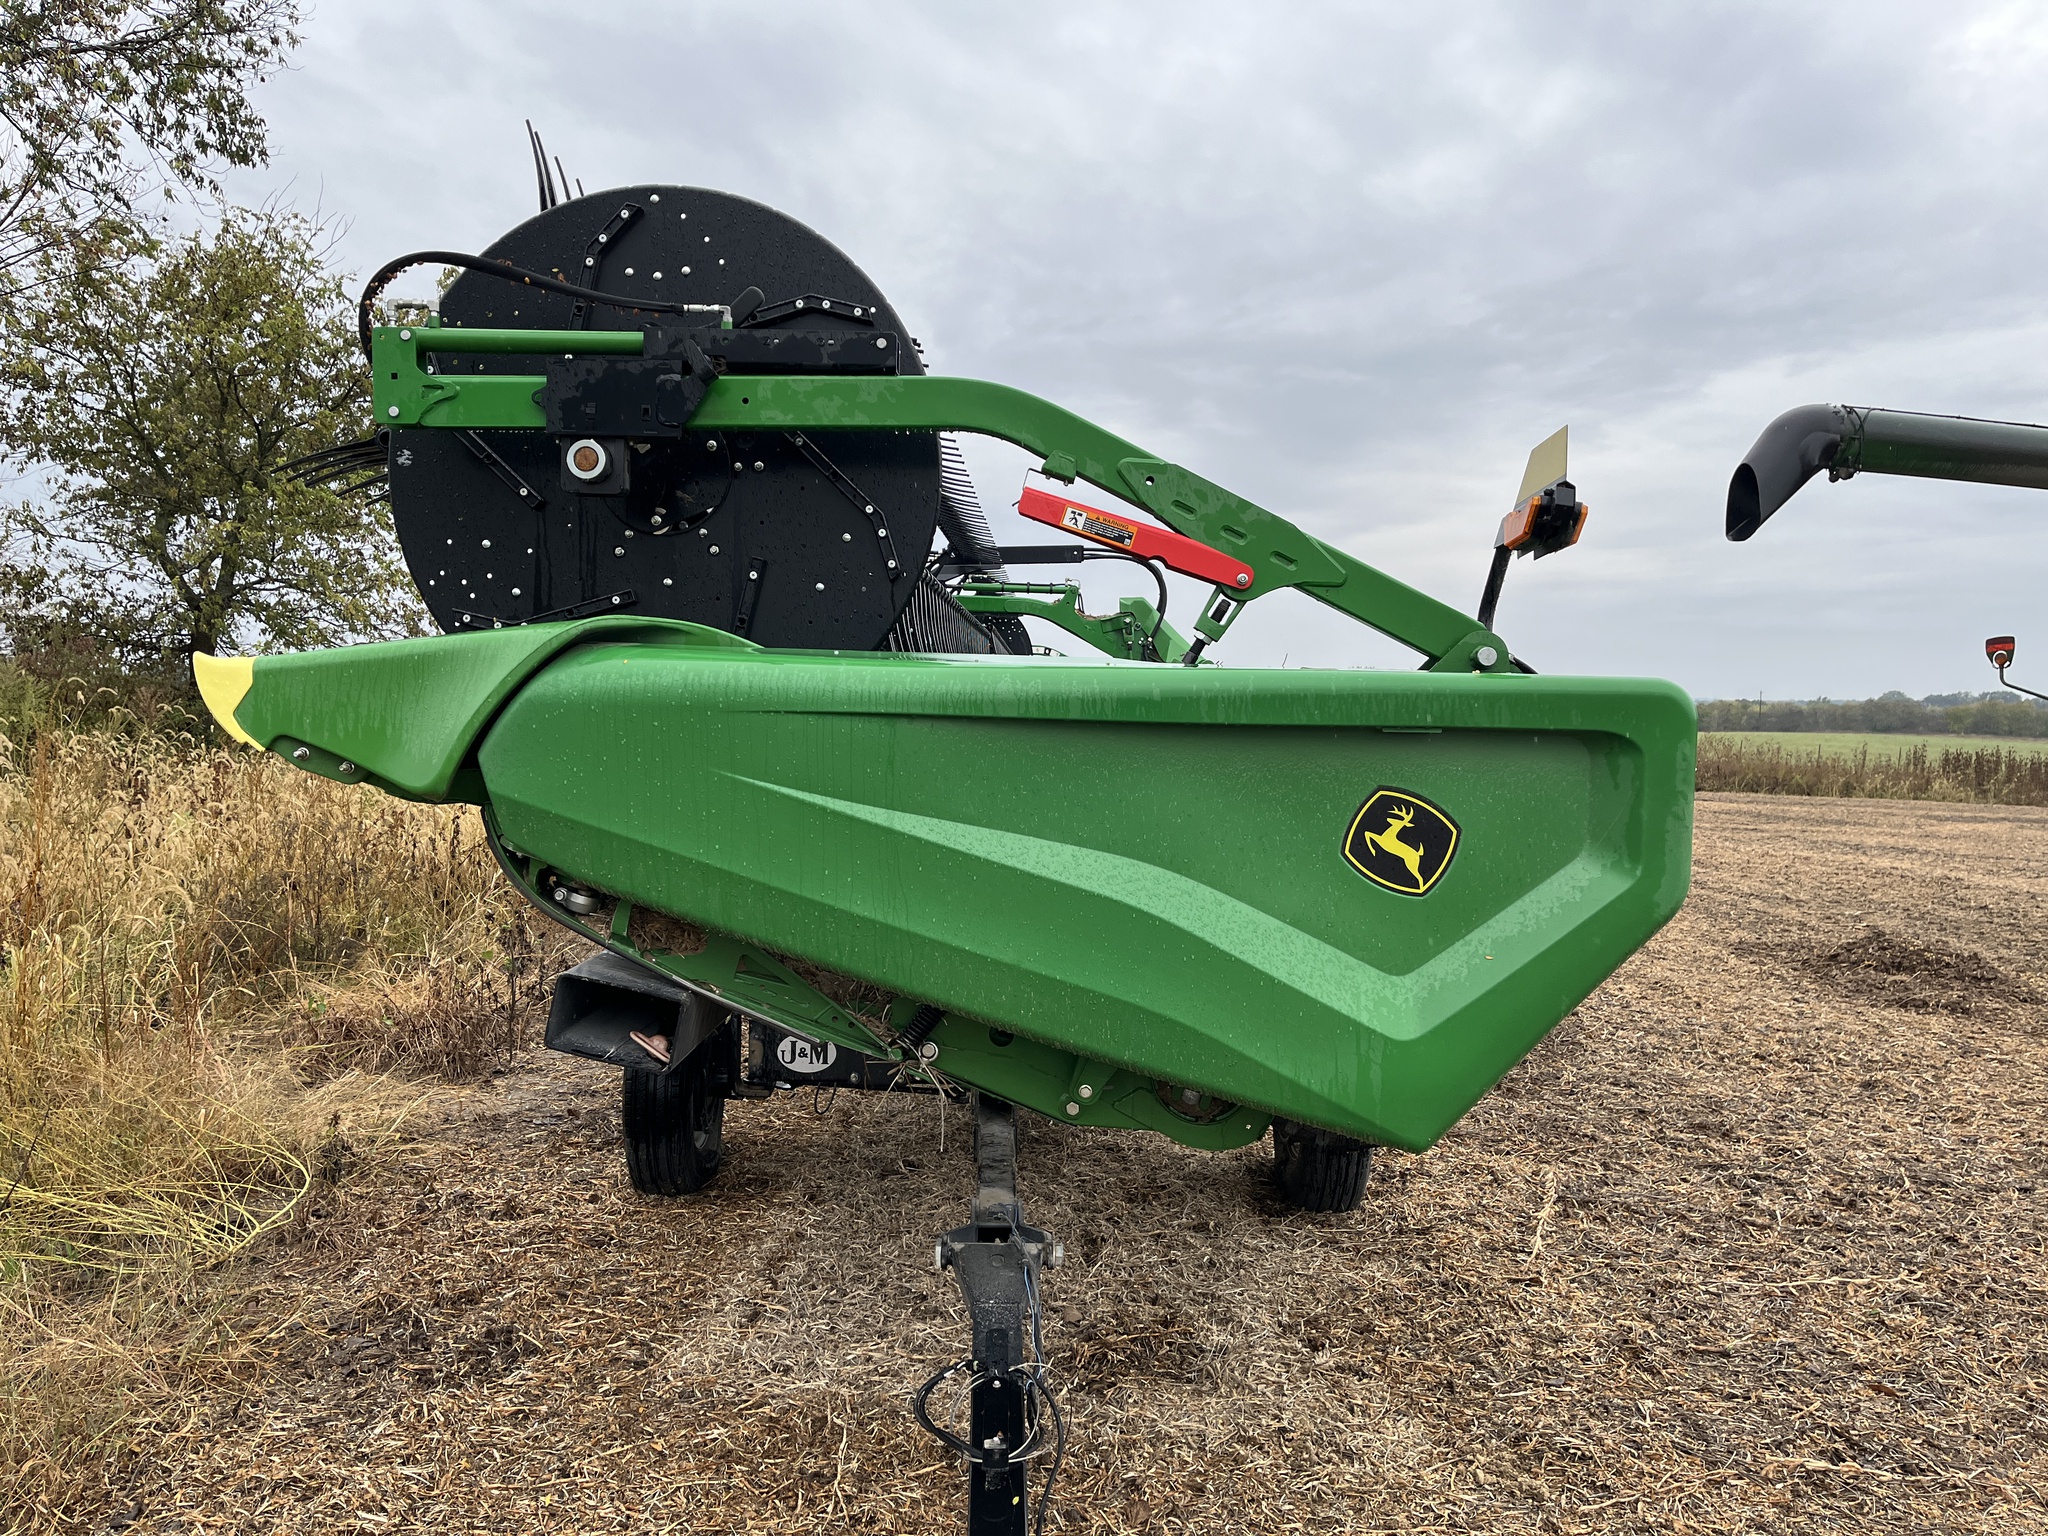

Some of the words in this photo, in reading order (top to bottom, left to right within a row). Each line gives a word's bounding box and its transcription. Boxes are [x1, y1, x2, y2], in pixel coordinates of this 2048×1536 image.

[763, 336, 771, 346] 2
[1102, 517, 1129, 530] WARNING
[780, 1040, 829, 1065] J&M
